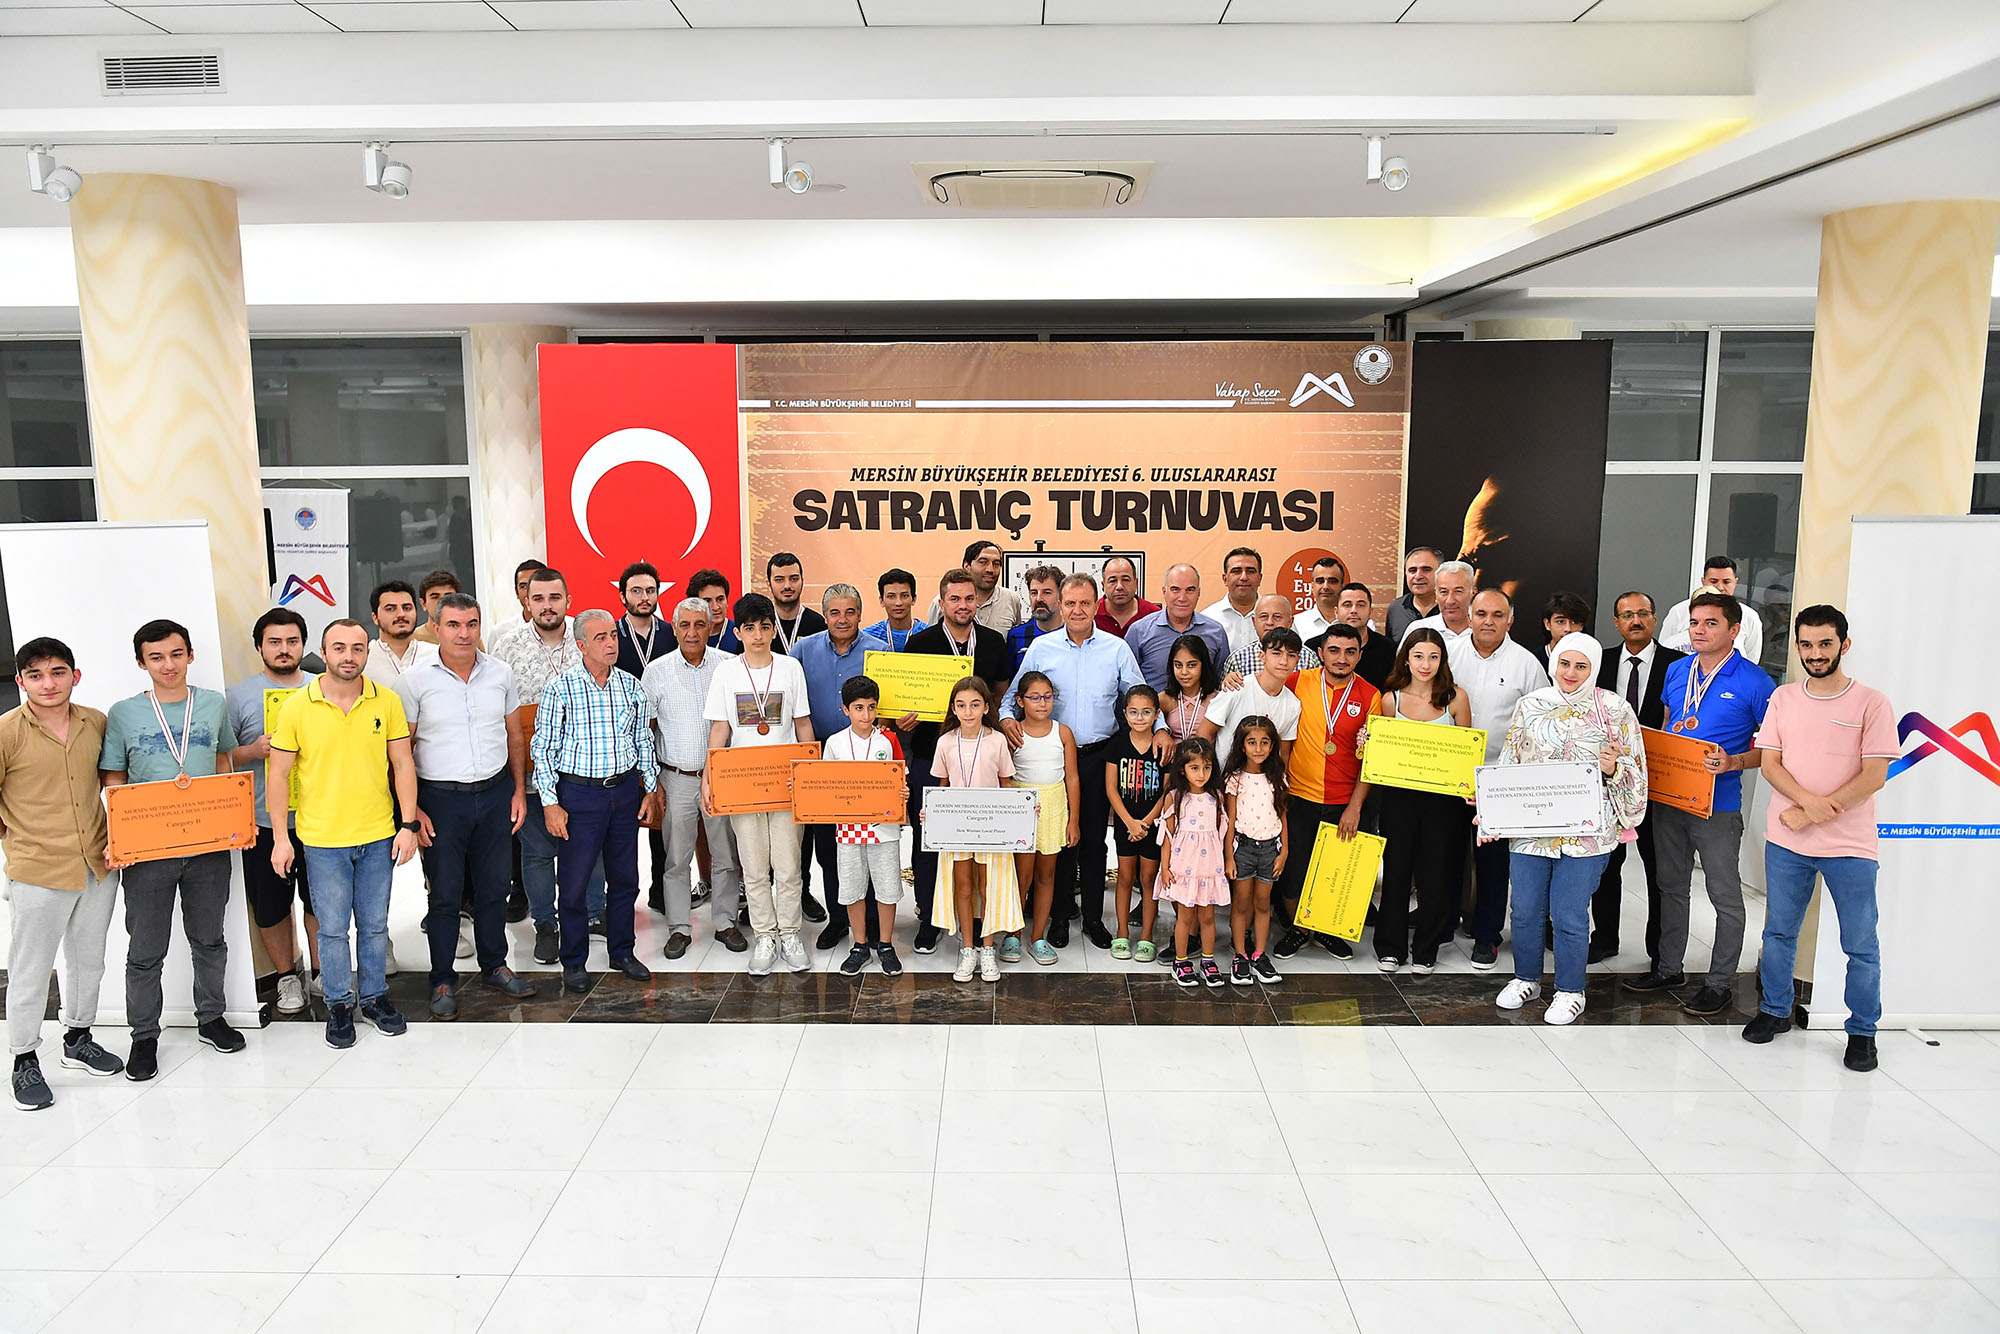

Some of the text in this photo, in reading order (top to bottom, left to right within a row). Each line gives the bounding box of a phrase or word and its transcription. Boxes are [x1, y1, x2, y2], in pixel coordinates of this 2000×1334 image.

[1215, 381, 1250, 404] Vahap
[774, 398, 912, 409] T.C. MERSİN BÜYÜKŞEHİR BELEDİYESİ
[850, 465, 1277, 486] MERSİN BÜYÜKŞEHİR BELEDİYESİ 6. ULUSLARARASI
[793, 489, 1334, 540] SATRANÇ TURNUVASI
[1294, 561, 1303, 574] 4
[1890, 826, 1922, 836] MERSİN
[1924, 826, 1976, 837] BÜYÜKŞEHİR
